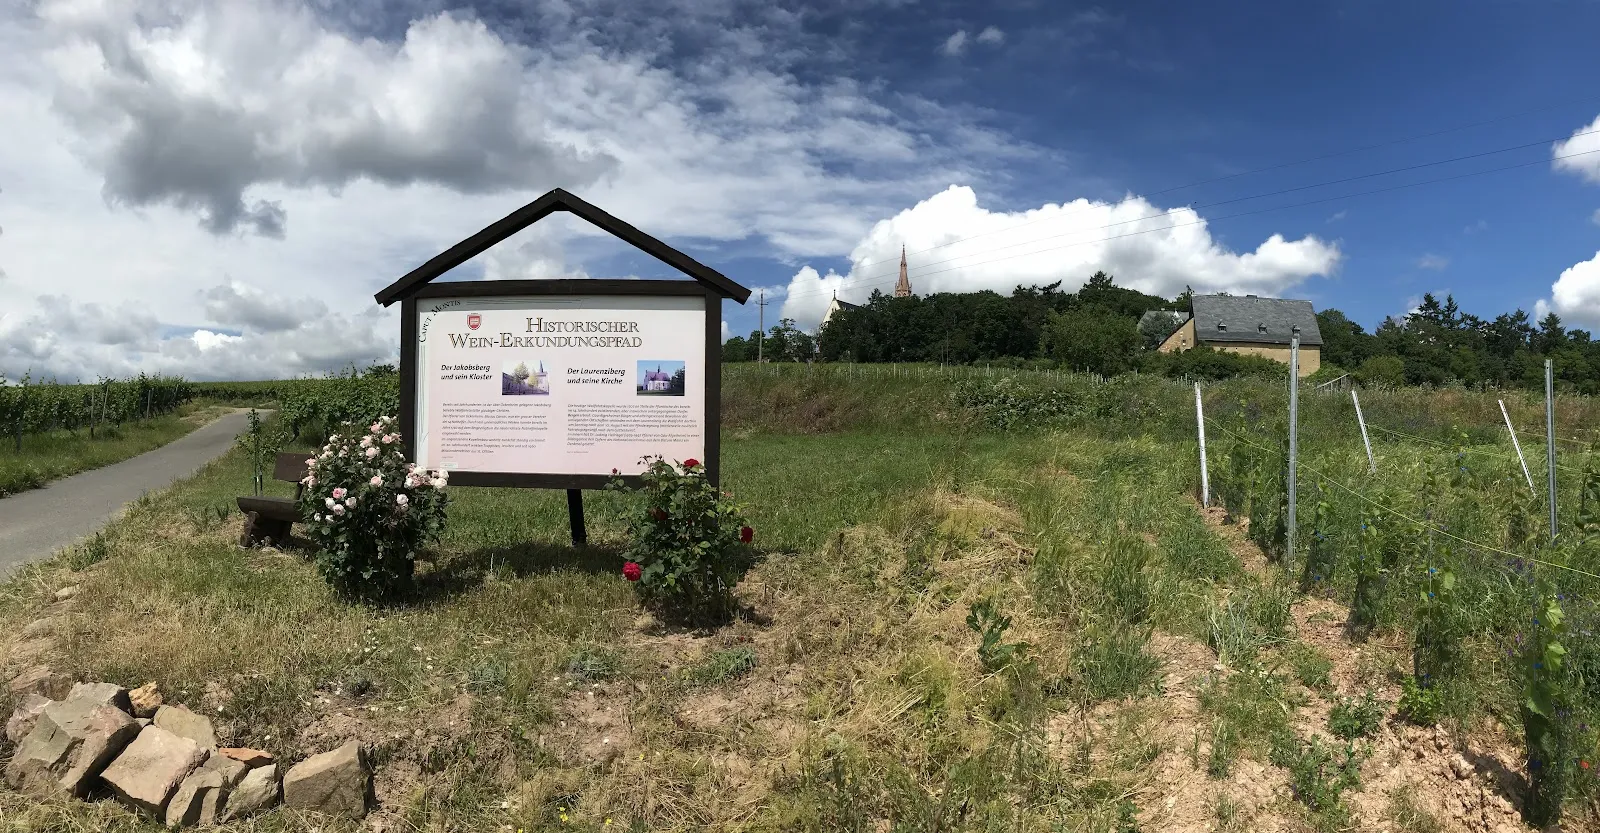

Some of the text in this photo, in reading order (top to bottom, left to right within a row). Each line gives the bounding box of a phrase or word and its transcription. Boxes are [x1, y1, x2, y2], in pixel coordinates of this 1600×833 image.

[418, 300, 461, 343] CAPUT MONTIS
[525, 317, 640, 333] HISTORISCHER
[447, 332, 643, 348] WEIN-ERKUNDUNGSPFAD
[453, 364, 491, 373] Jakobsberg
[580, 368, 626, 377] Laurenziberg
[601, 377, 623, 385] Kirche
